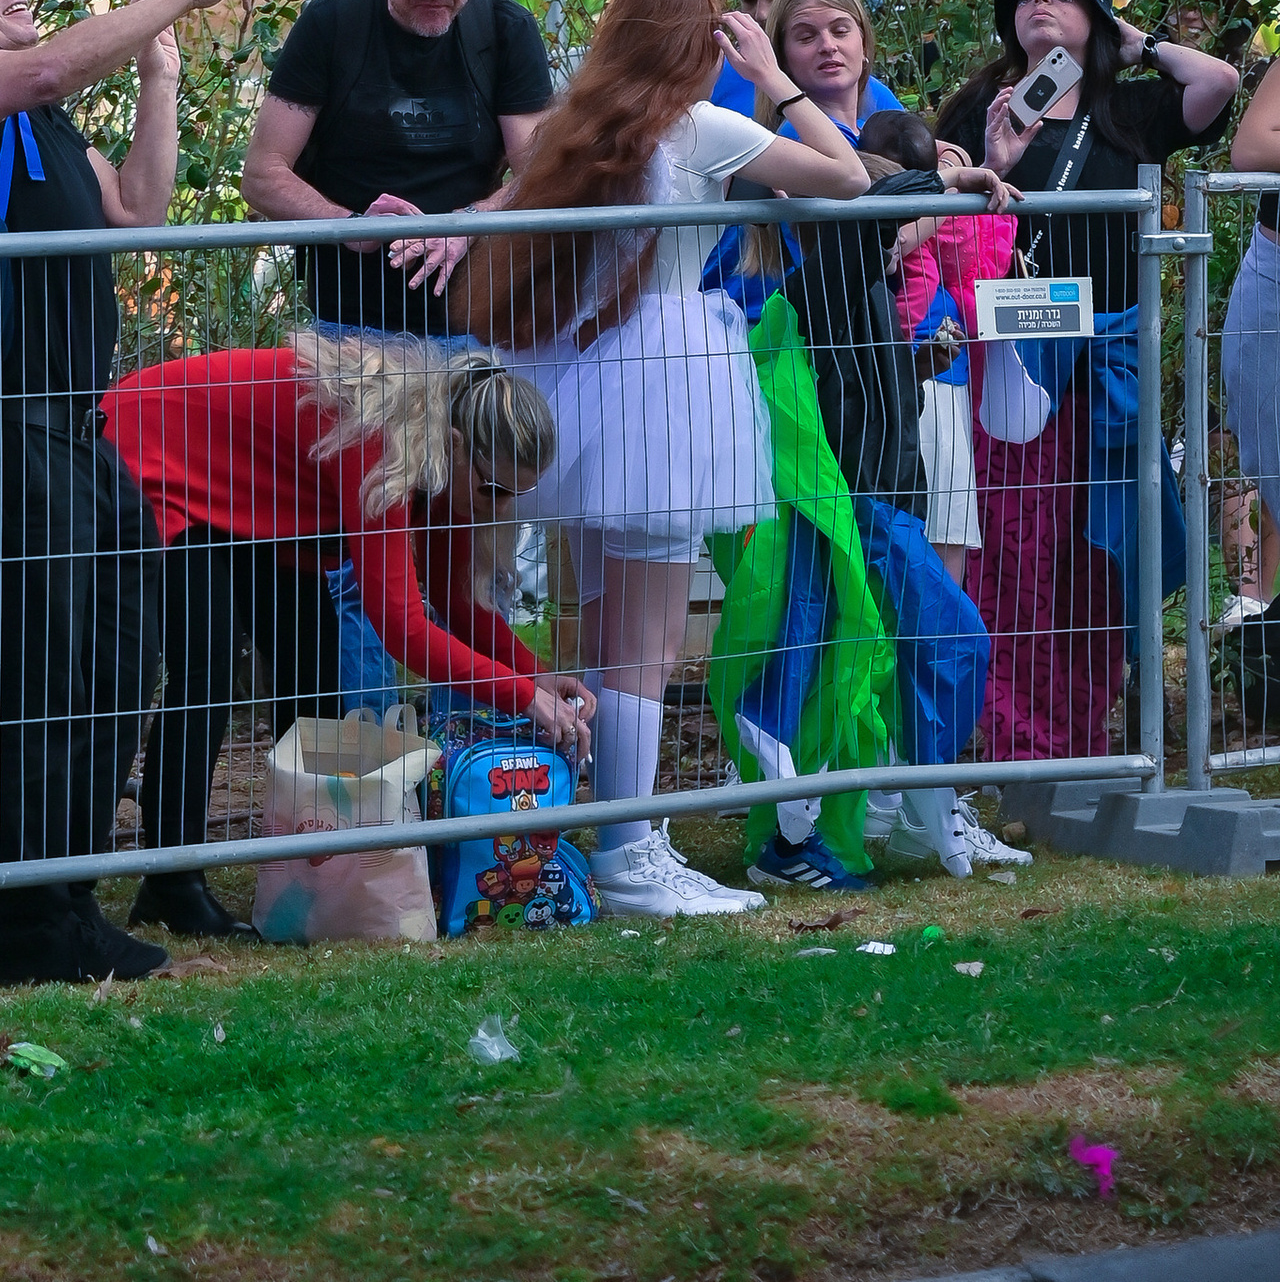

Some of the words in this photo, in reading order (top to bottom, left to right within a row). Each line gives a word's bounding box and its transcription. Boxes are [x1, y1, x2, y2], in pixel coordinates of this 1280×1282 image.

[996, 293, 1046, 301] www.out-door.co.il
[1017, 310, 1042, 320] זמנית
[1046, 309, 1060, 319] גדר
[501, 757, 540, 771] BRAWL
[488, 765, 550, 795] STARS
